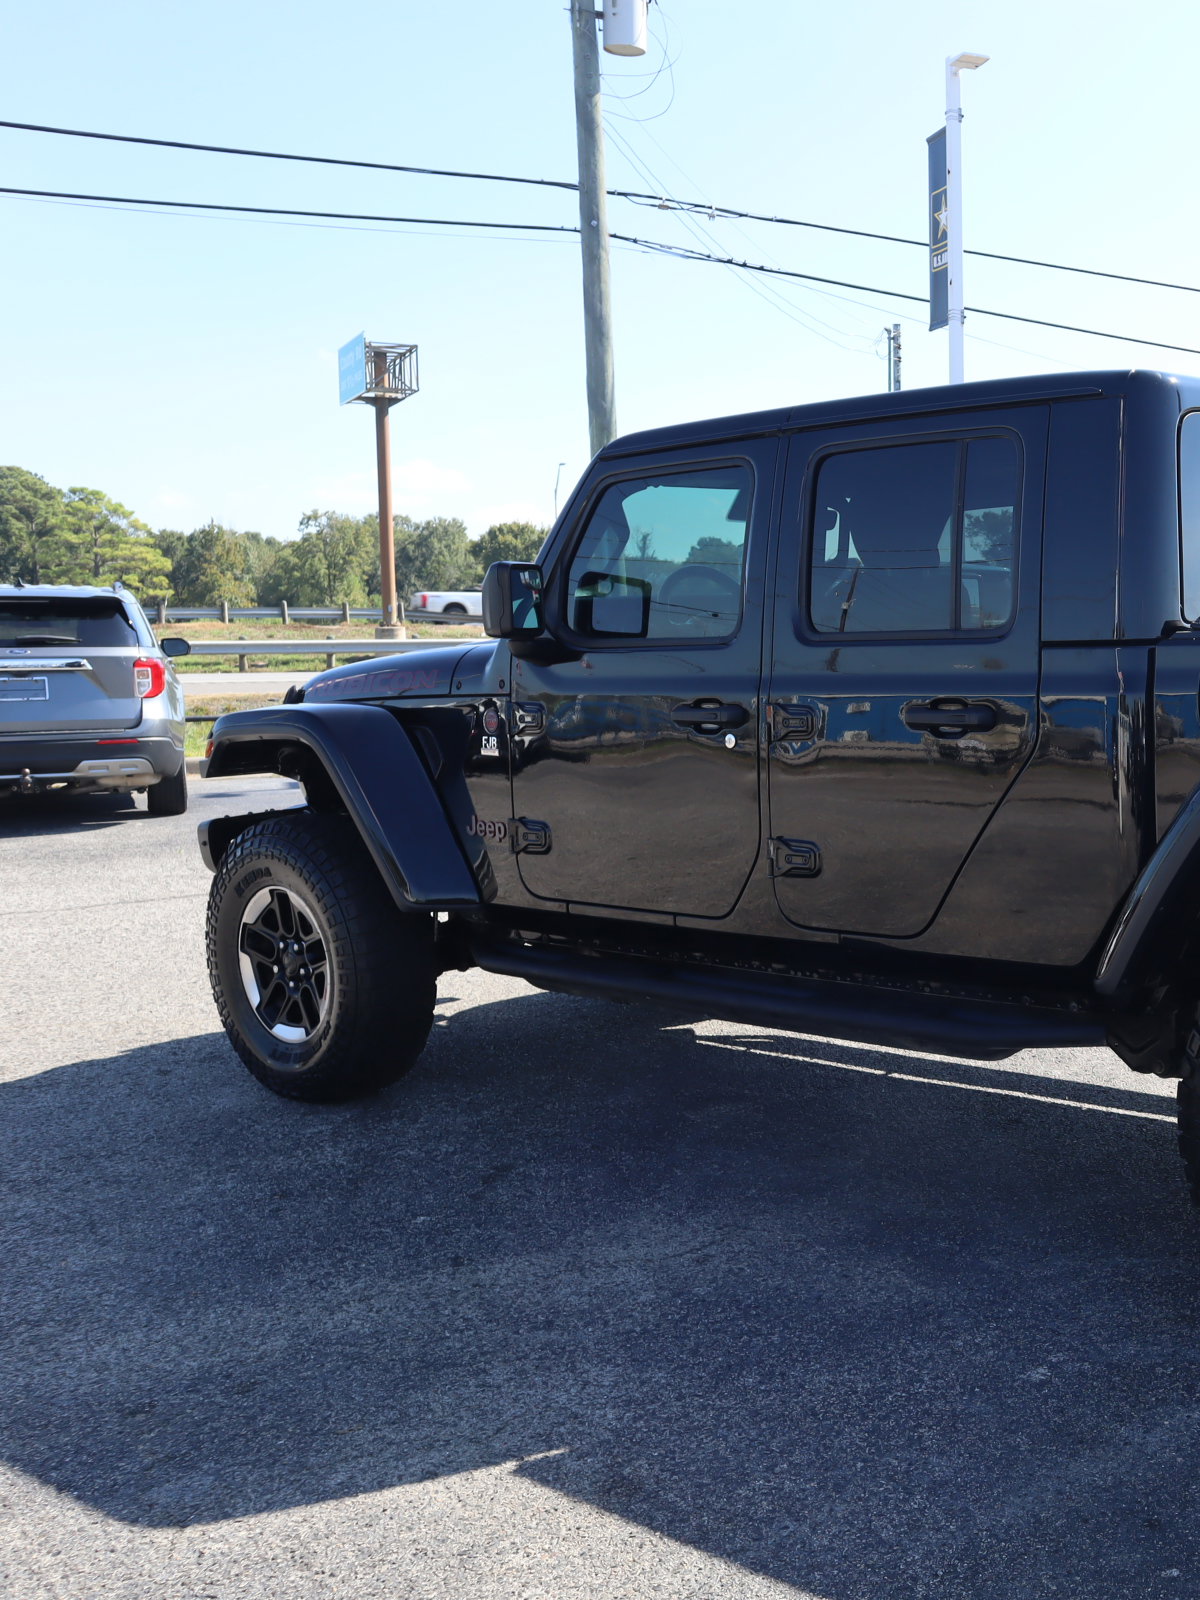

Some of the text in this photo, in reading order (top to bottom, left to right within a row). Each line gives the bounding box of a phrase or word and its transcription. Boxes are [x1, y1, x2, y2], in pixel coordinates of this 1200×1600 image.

[312, 669, 439, 697] RUBICON
[482, 735, 497, 749] FJB
[466, 815, 507, 842] Jeep
